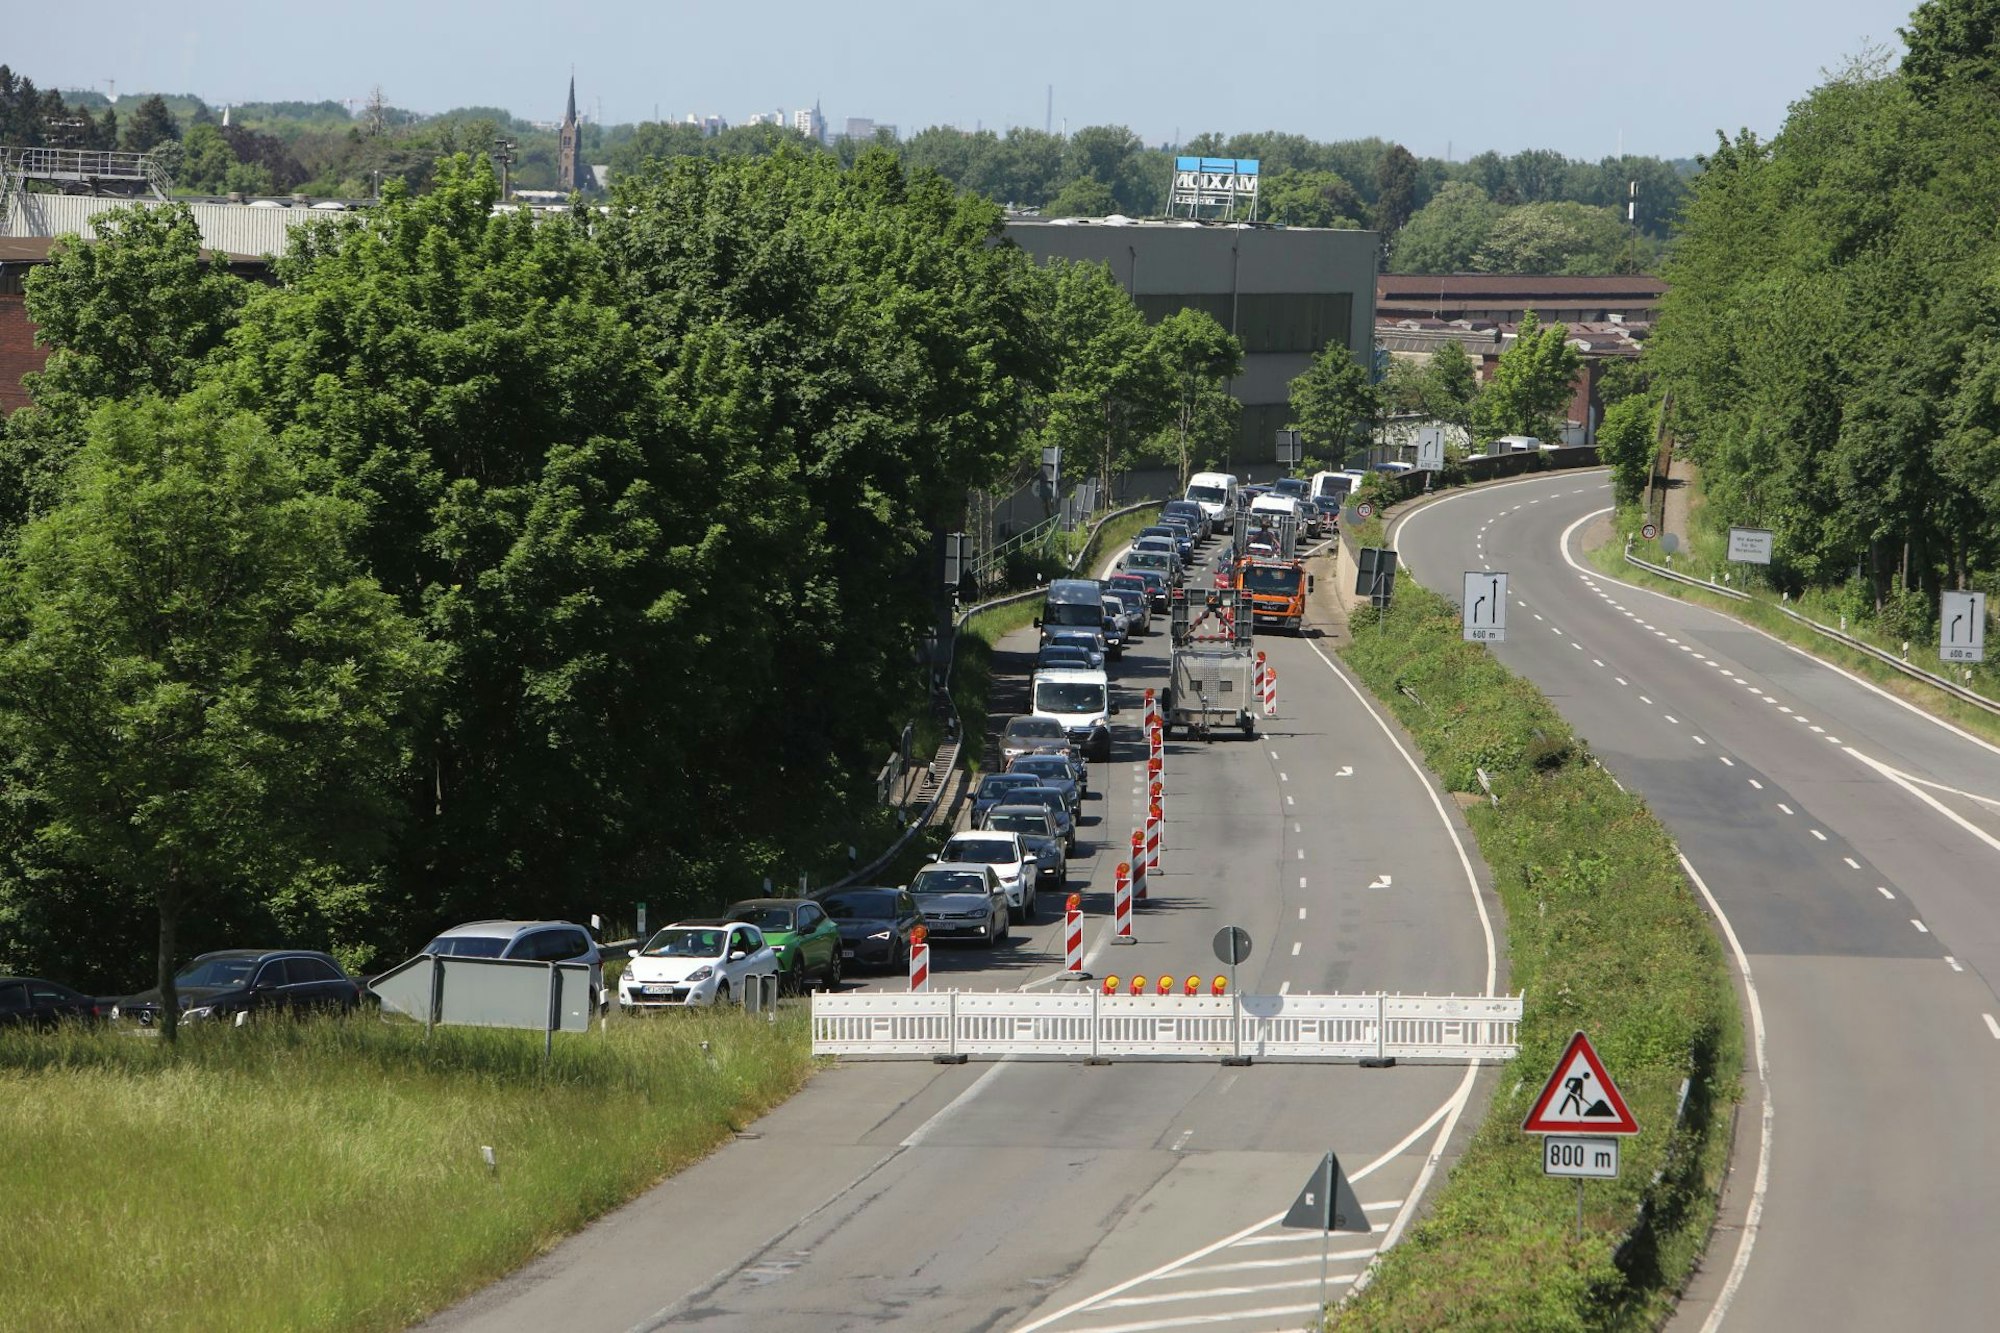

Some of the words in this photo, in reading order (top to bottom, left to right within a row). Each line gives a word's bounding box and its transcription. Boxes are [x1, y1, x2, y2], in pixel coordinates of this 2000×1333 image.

[1645, 528, 1654, 536] 70
[1473, 631, 1486, 639] 600
[1950, 650, 1963, 658] 600
[1550, 1144, 1585, 1168] 800
[1595, 1151, 1611, 1168] m
